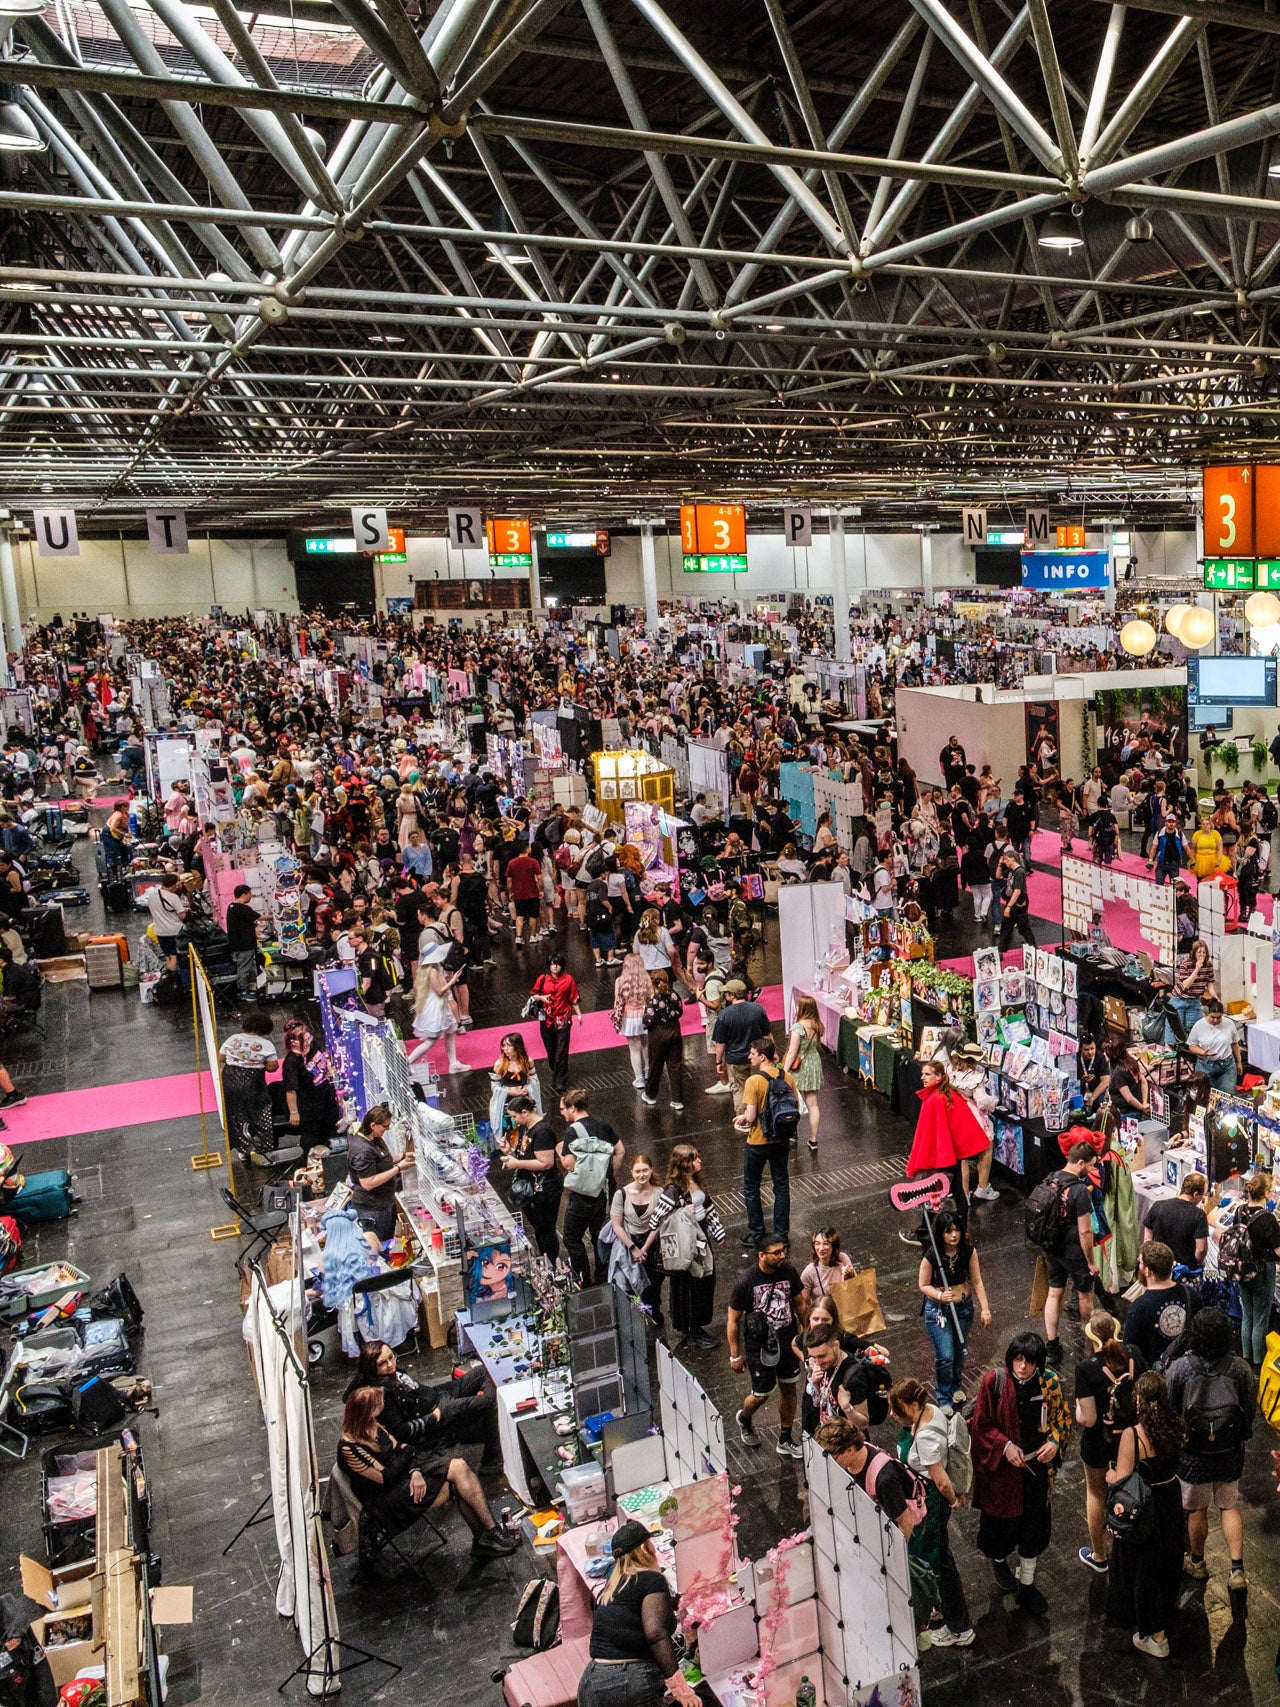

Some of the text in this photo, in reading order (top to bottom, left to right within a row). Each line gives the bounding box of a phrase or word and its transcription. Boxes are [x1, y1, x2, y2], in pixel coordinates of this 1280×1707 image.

[43, 516, 69, 550] U
[156, 515, 176, 548] T
[361, 513, 380, 545] S
[456, 514, 475, 543] R
[685, 520, 692, 550] 3
[713, 520, 731, 550] 3
[791, 513, 805, 541] P
[968, 513, 982, 540] N
[1028, 513, 1048, 540] M
[1219, 494, 1237, 548] 3
[506, 530, 520, 551] 3
[1060, 533, 1065, 545] 3
[1073, 532, 1080, 546] 3
[1043, 564, 1090, 579] INFO
